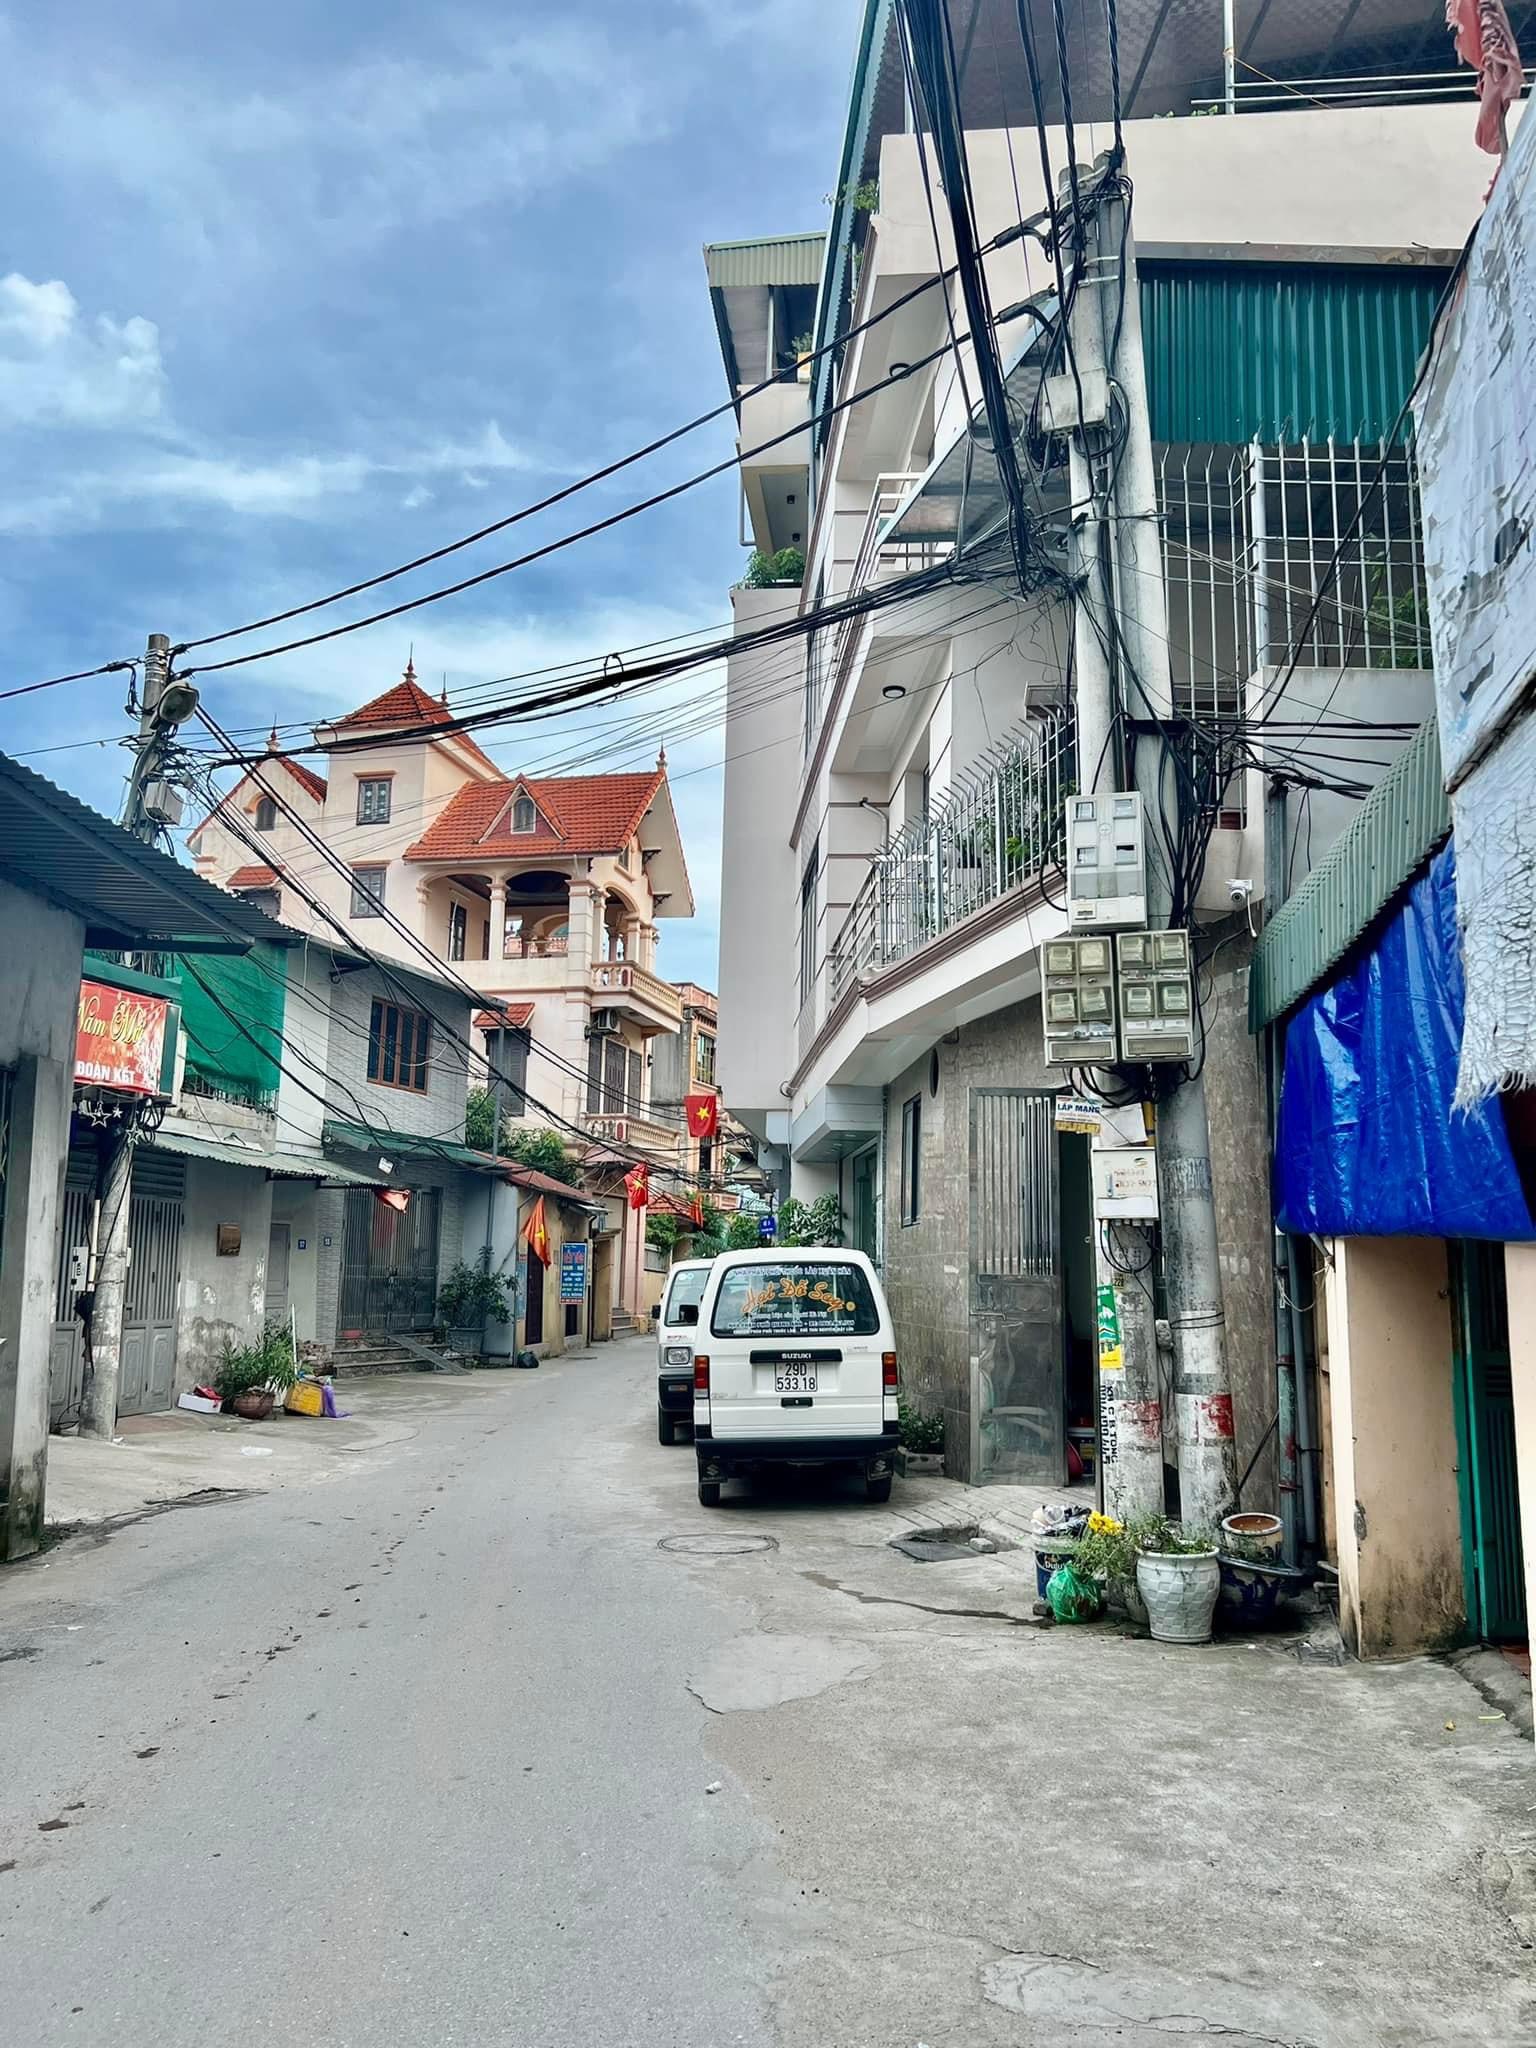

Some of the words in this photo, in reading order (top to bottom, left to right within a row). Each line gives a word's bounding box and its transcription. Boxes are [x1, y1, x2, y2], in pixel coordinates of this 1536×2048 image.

[781, 1352, 811, 1360] SUZUKI
[785, 1362, 807, 1377] 29D
[776, 1377, 816, 1391] 533.18
[1045, 1560, 1065, 1569] Dulu
